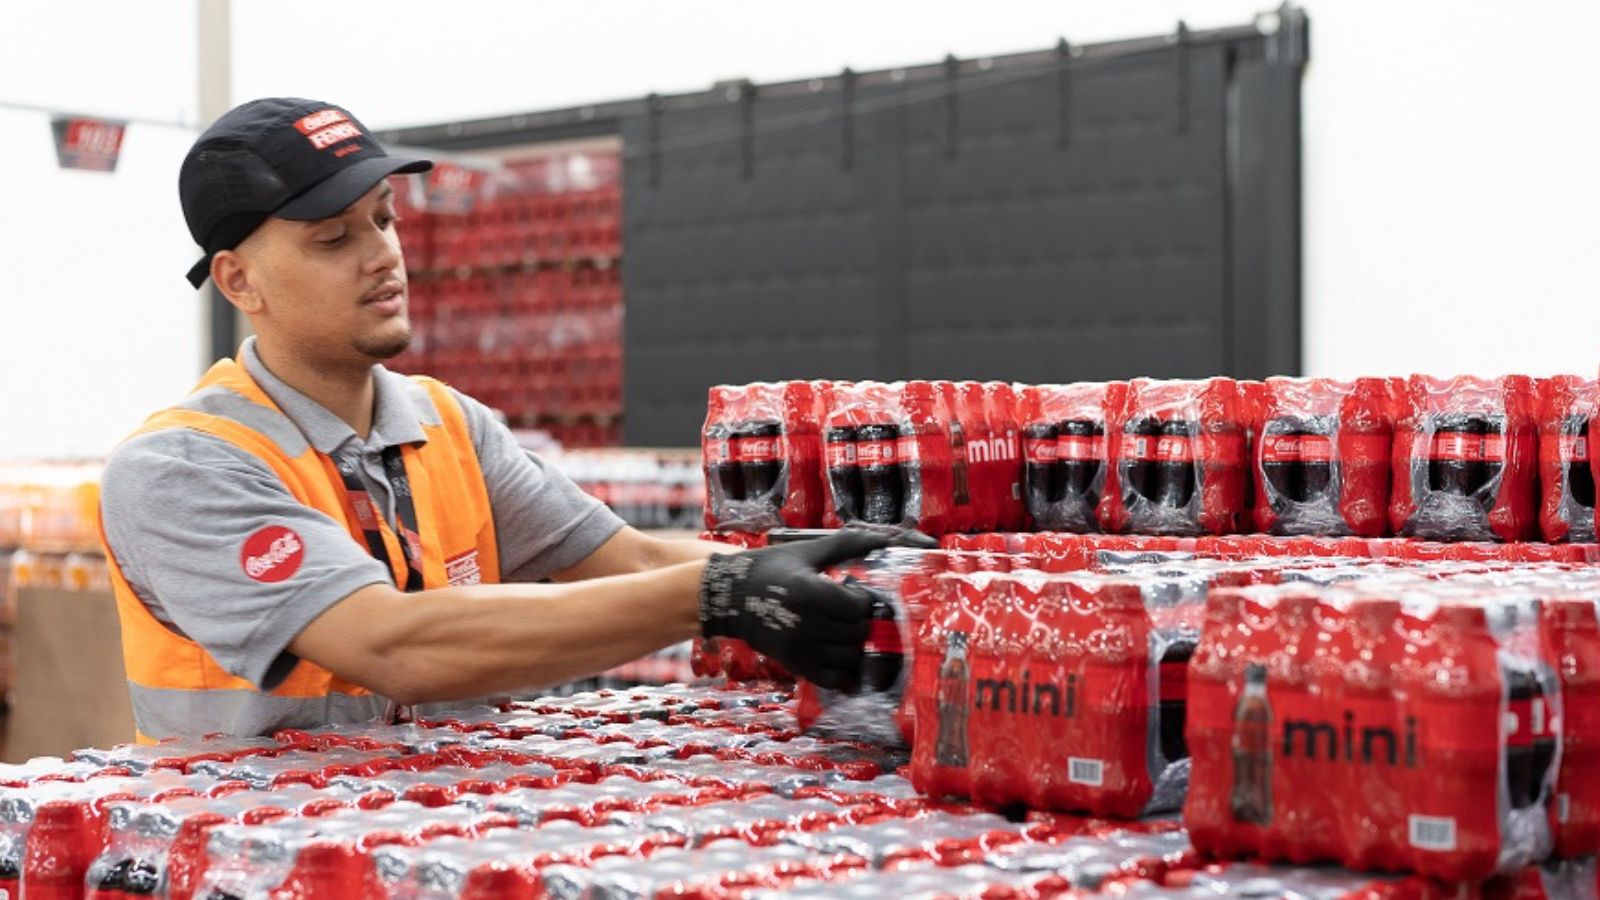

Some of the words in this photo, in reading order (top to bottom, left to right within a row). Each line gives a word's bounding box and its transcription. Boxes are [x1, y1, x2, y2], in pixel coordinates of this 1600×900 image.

[967, 429, 1016, 463] mini
[976, 669, 1076, 717] mini
[1282, 710, 1418, 768] mini
